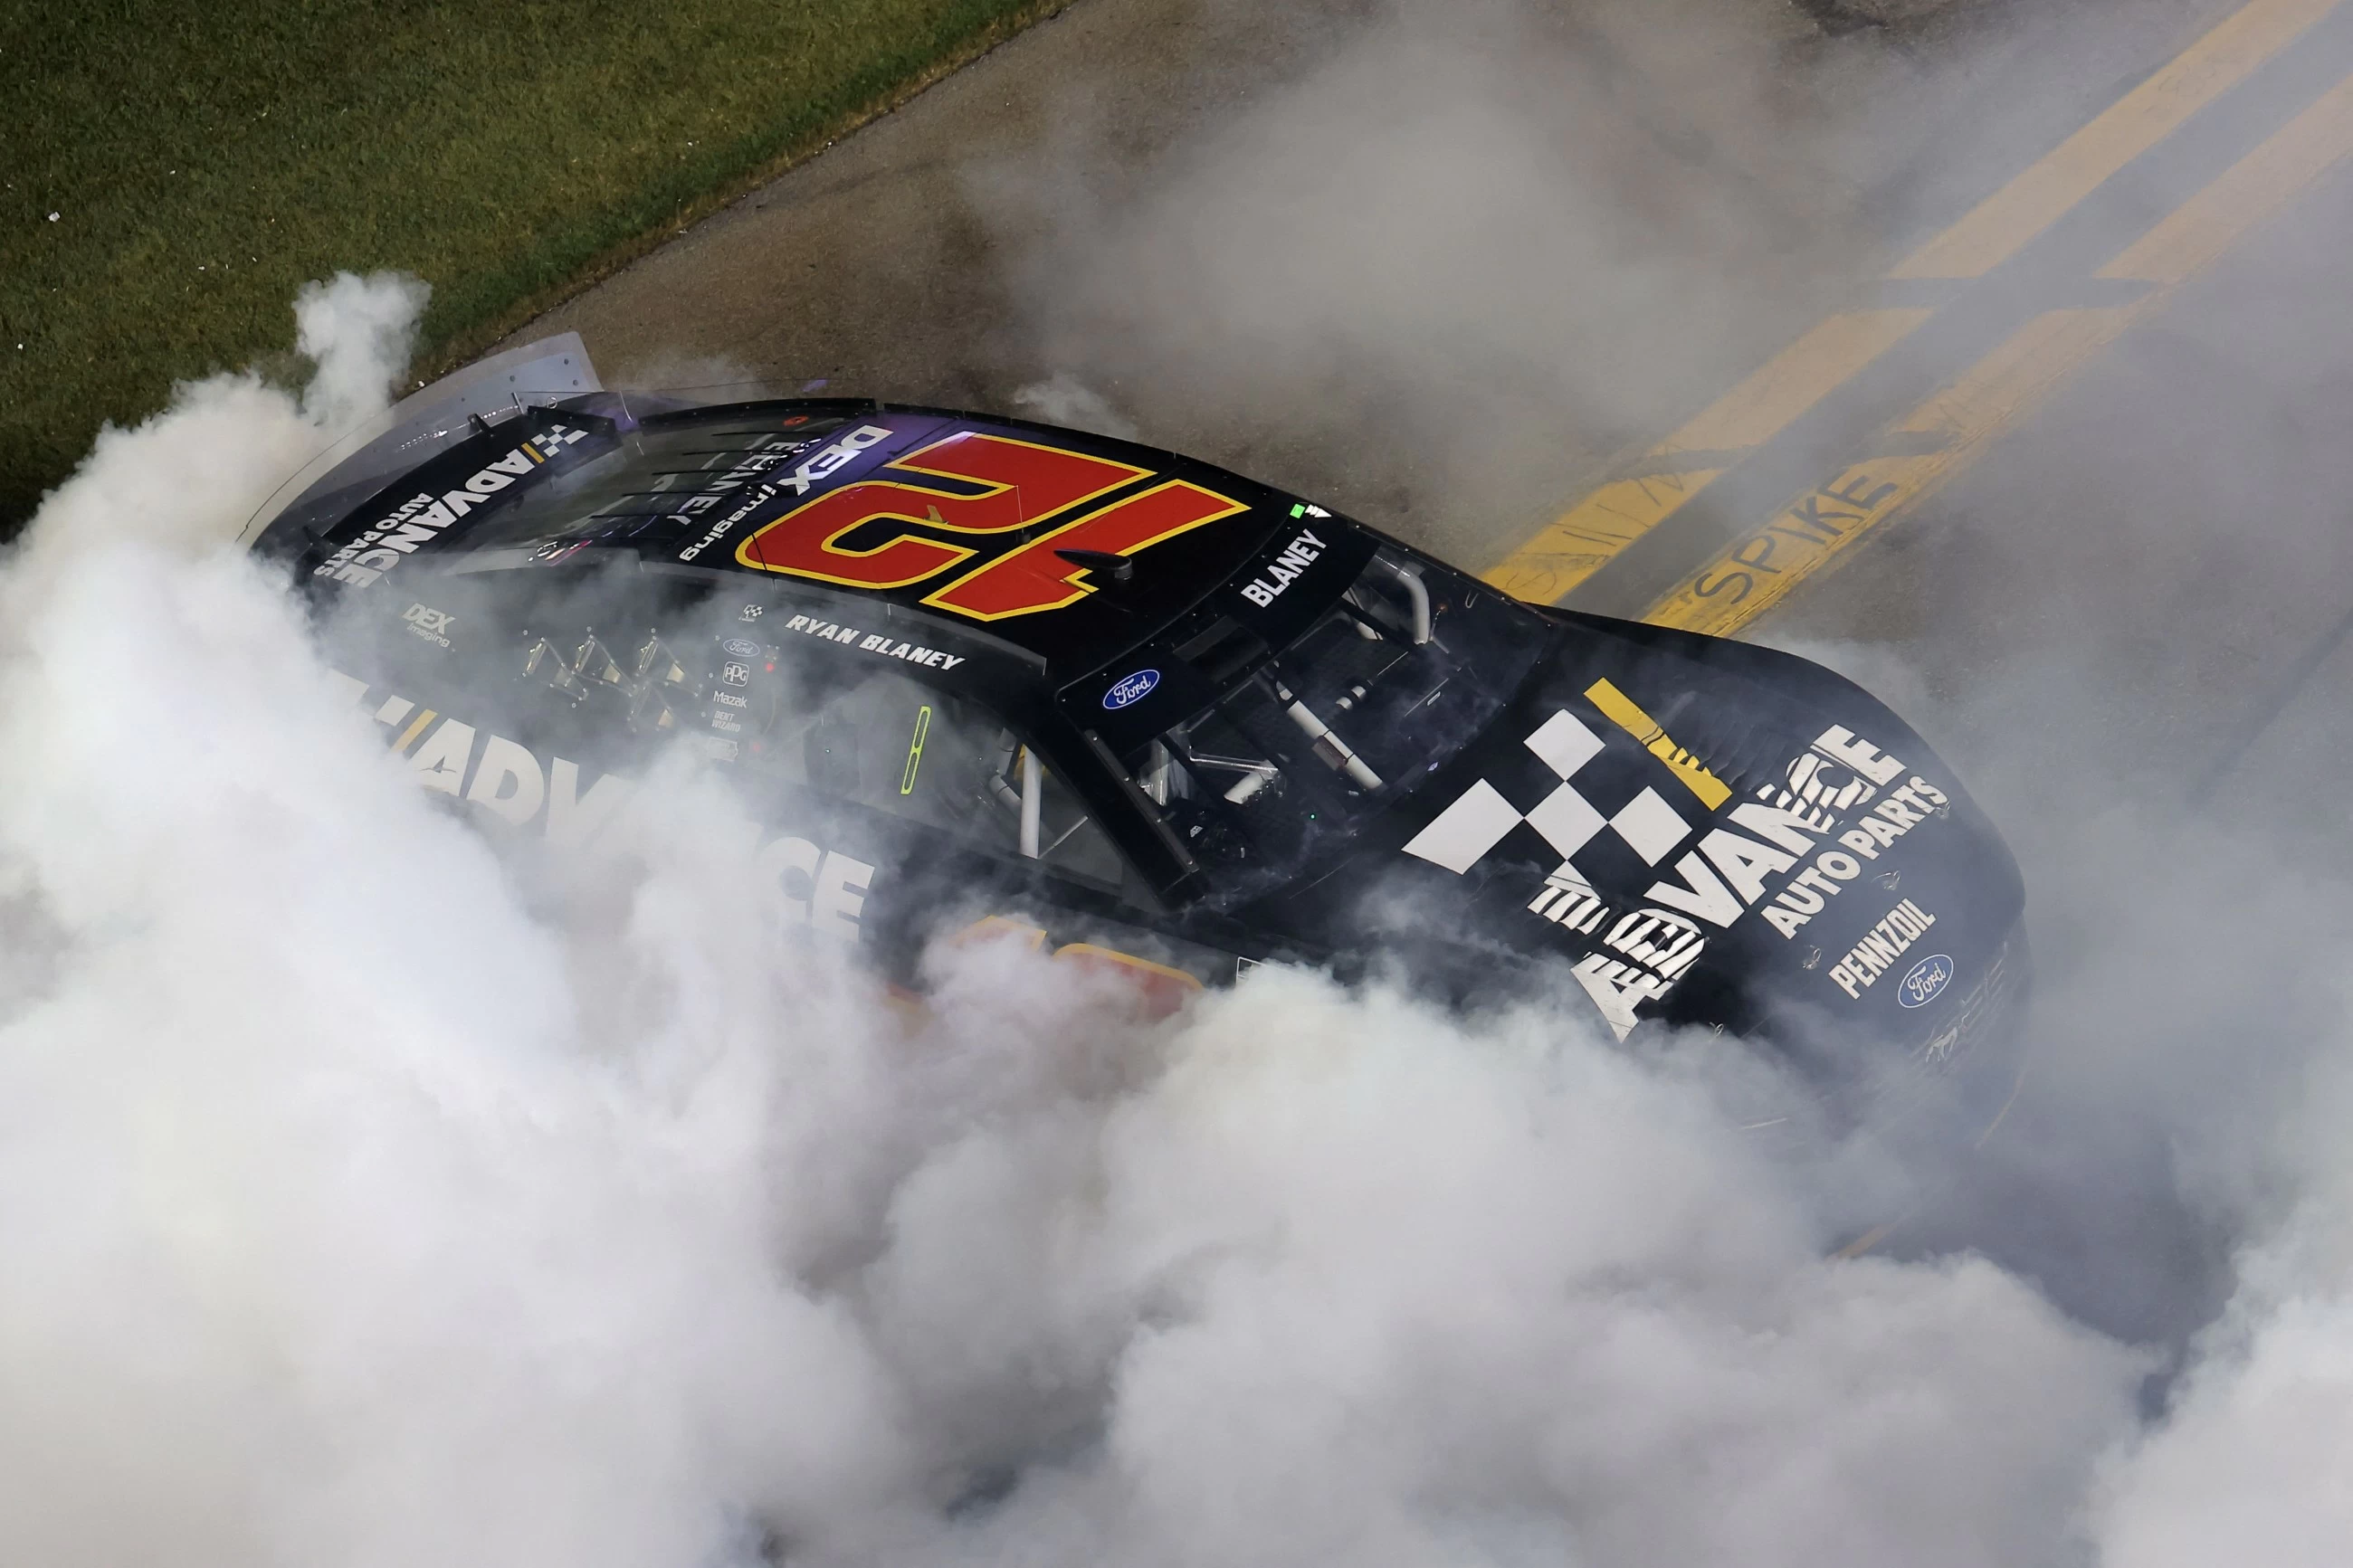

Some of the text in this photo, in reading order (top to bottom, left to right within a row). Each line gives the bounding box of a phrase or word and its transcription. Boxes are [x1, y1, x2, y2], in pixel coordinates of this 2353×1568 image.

[776, 424, 894, 497] DEX
[313, 492, 434, 576] AUTO PARTS
[332, 449, 536, 588] ADVANCE
[679, 484, 777, 561] imaging
[735, 431, 1253, 622] 12
[1694, 475, 1898, 605] SPIKE
[1241, 528, 1327, 608] BLANEY
[401, 603, 456, 634] DEX
[406, 622, 451, 648] imaging
[729, 640, 754, 656] Ford
[785, 614, 966, 670] RYAN BLANEY
[713, 690, 748, 708] Mazak
[724, 664, 748, 683] PPG
[1111, 673, 1153, 706] Ford
[413, 718, 876, 943] ADVCE
[1760, 775, 1948, 939] AUTO PARTS
[1828, 898, 1937, 999] PENNZOIL
[1905, 961, 1948, 1003] Ford
